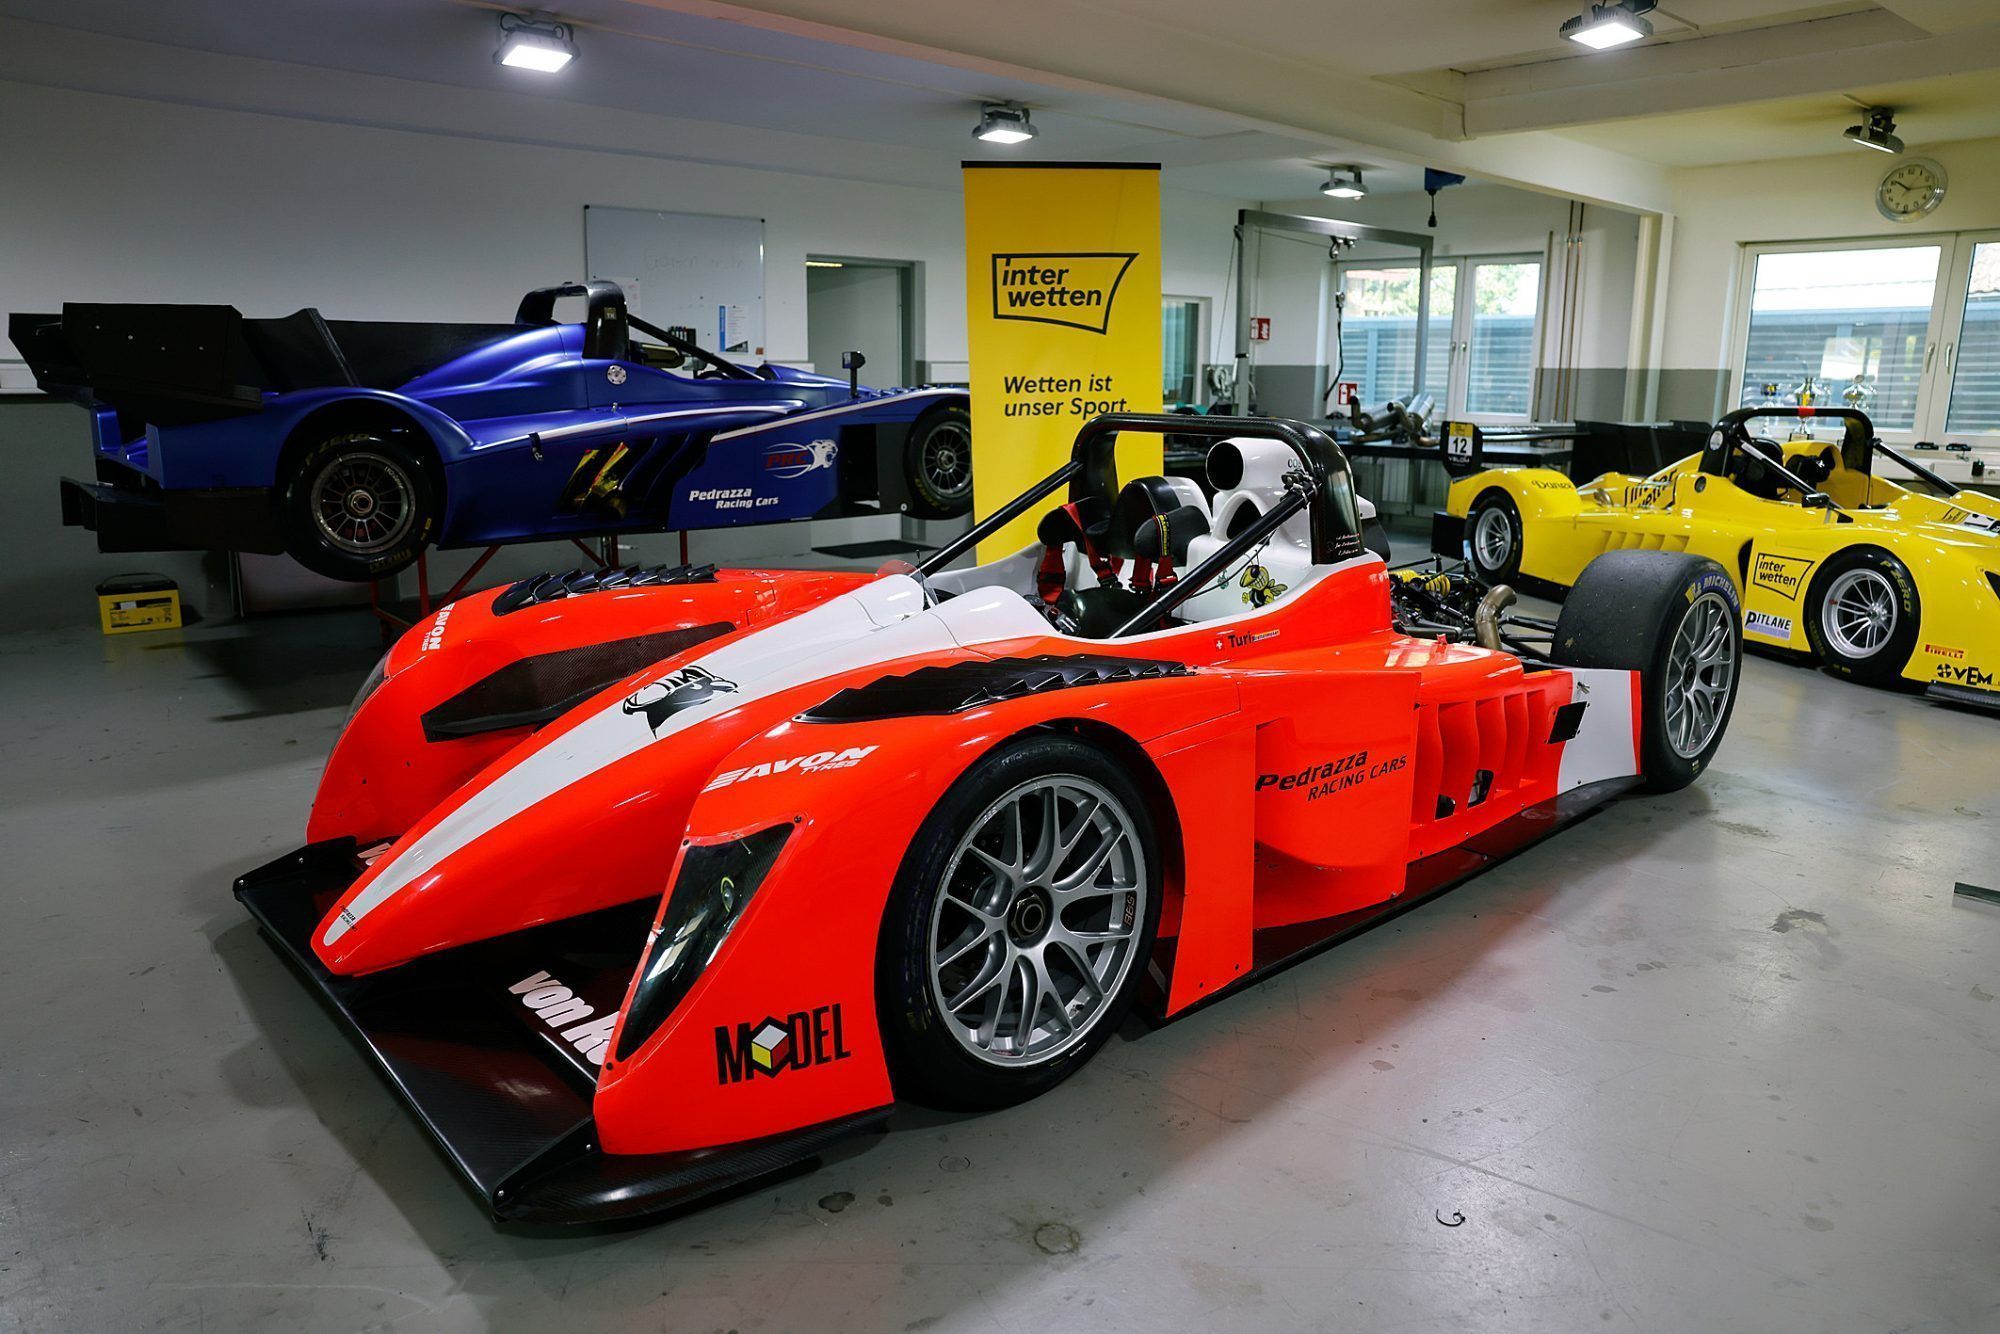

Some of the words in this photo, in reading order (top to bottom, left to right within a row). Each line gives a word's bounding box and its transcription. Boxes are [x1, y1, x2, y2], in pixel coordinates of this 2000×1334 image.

[1002, 258, 1069, 286] inter
[1008, 286, 1102, 308] wetten
[1004, 376, 1081, 394] Wetten
[1088, 374, 1113, 392] ist
[1004, 401, 1064, 416] unser
[1069, 397, 1131, 420] Sport.
[1453, 437, 1467, 454] 12
[689, 488, 752, 501] Pedrazza
[715, 499, 753, 509] Racing
[756, 496, 779, 506] Cars
[1759, 554, 1785, 572] inter
[1760, 571, 1797, 587] wetten
[1703, 575, 1739, 608] MICHELIN
[1890, 568, 1912, 612] ZERO
[428, 610, 451, 650] AVON
[1744, 611, 1792, 631] PITLANE
[1228, 630, 1252, 648] Turi
[1925, 644, 1964, 659] PIRELLI
[1953, 666, 1994, 686] VEM
[736, 745, 881, 783] AVON
[800, 758, 862, 775] TYRES
[1255, 751, 1368, 791] Pedrazza
[1308, 770, 1365, 801] RACING
[1370, 755, 1408, 779] CARS
